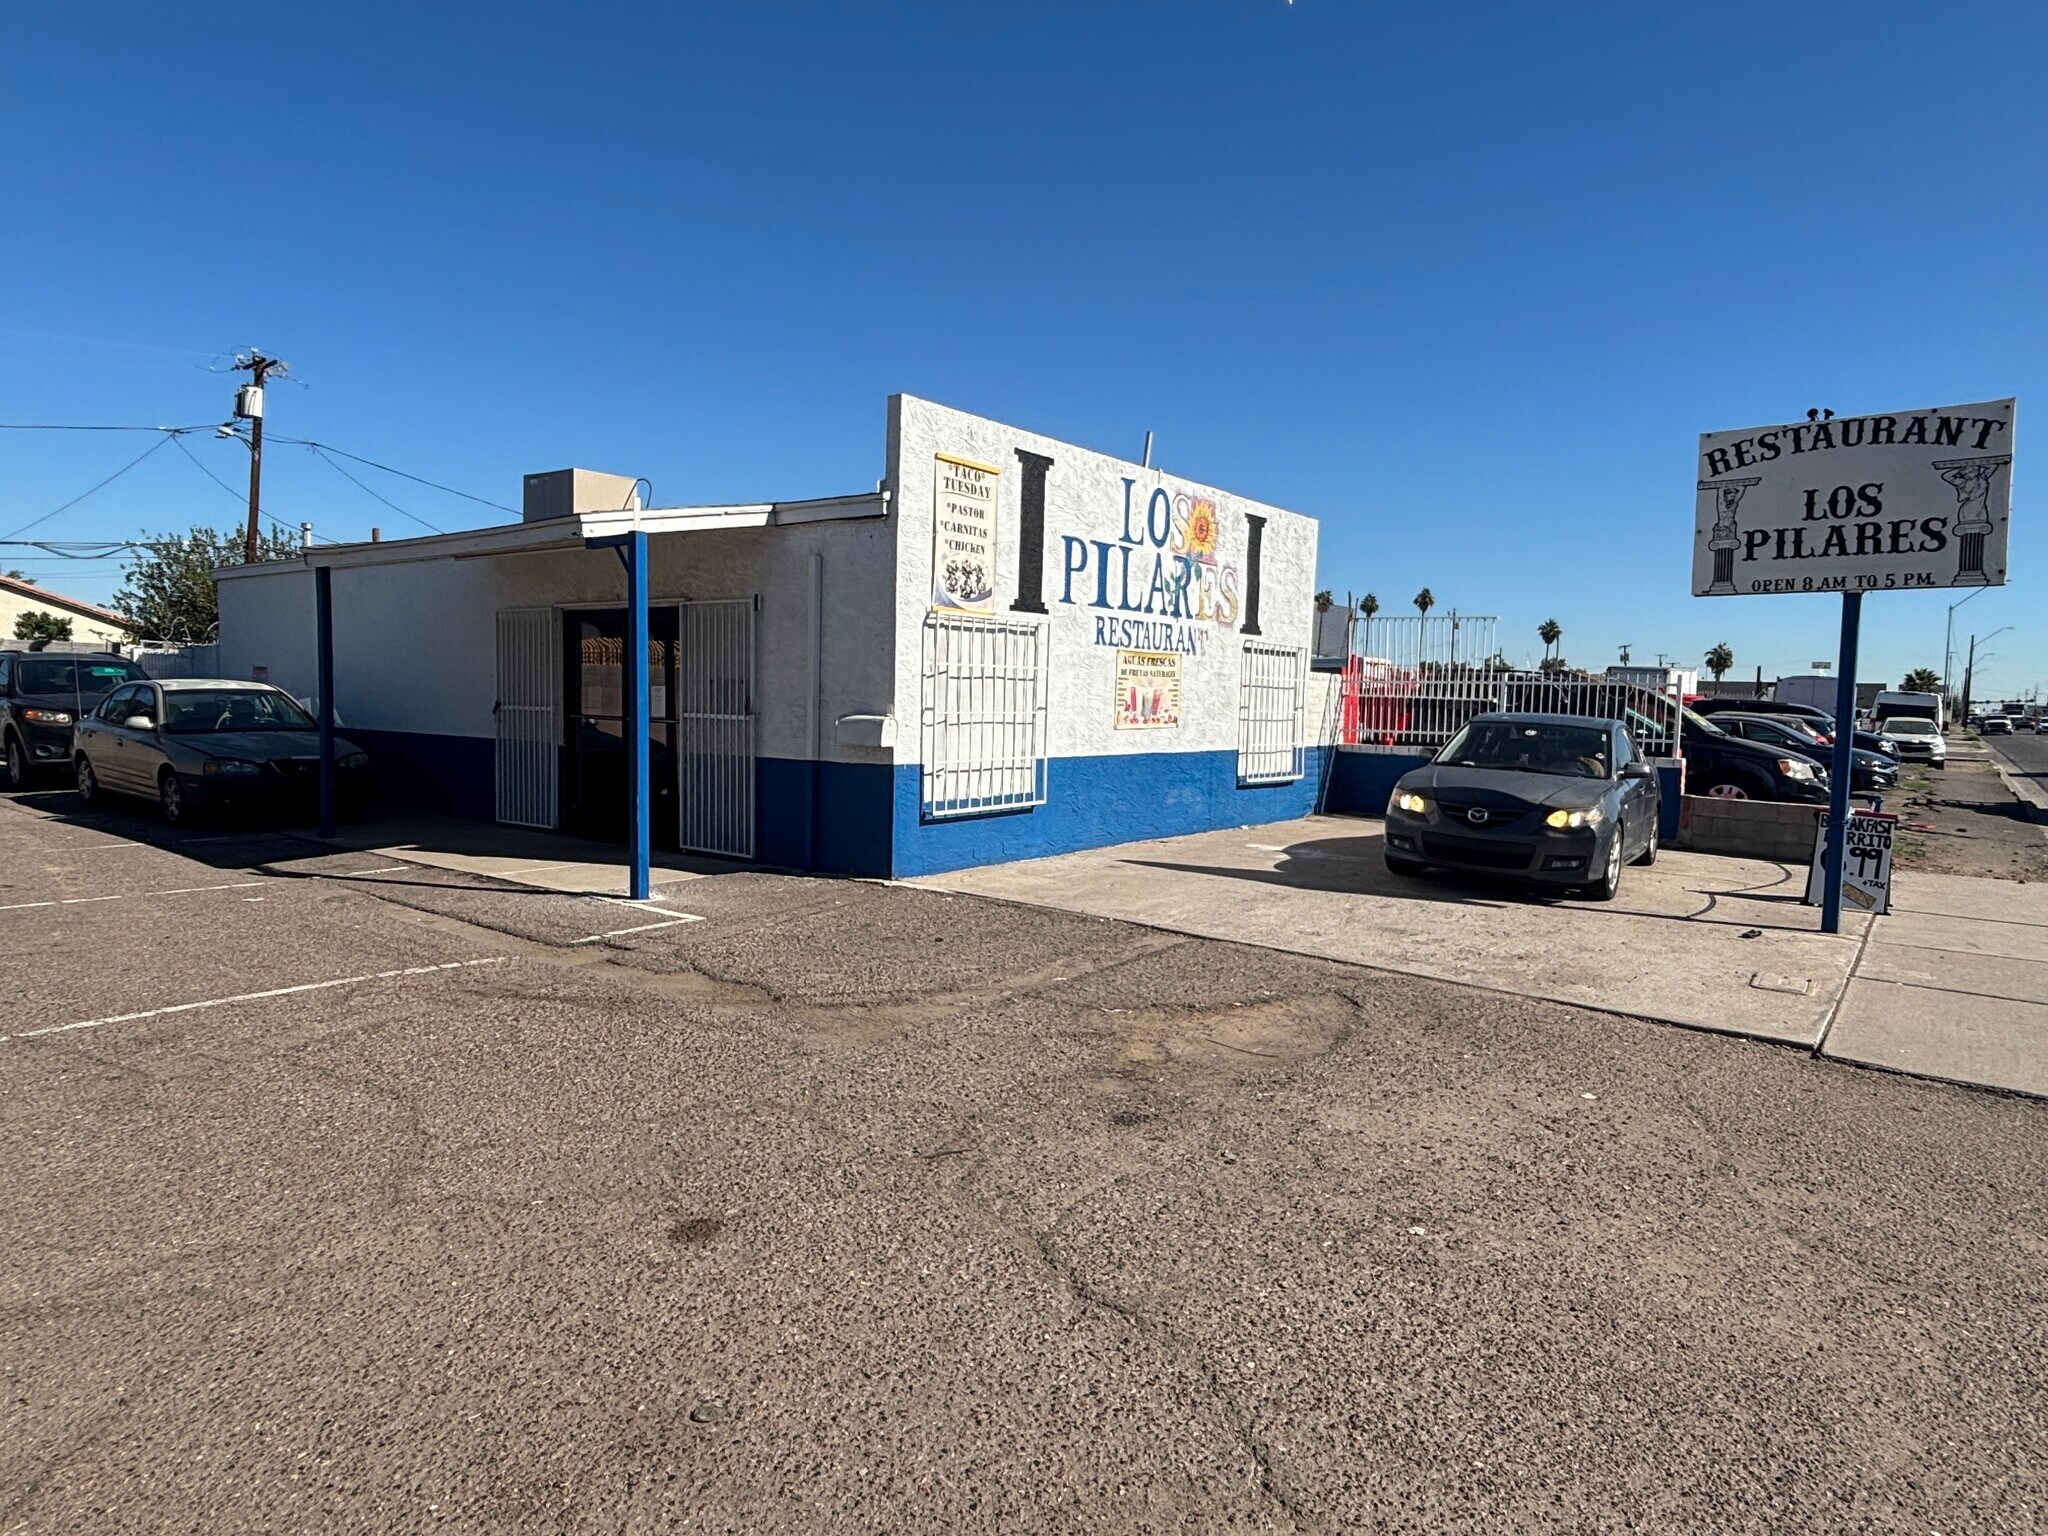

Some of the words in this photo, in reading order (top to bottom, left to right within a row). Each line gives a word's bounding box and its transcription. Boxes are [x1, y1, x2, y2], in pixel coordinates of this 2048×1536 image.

[1703, 416, 2007, 478] RESTAURANT
[943, 477, 991, 499] TUESDAY
[1802, 483, 1884, 521] LOS
[1119, 477, 1192, 555] LOS
[1742, 517, 1948, 562] PILARES
[1058, 535, 1238, 625] PILARES
[1752, 578, 1795, 592] OPEN
[1802, 576, 1814, 591] 8
[1817, 576, 1847, 590] AM
[1855, 574, 1878, 588] TO
[1885, 573, 1896, 588] 5
[1094, 615, 1209, 656] RESTAURANT
[1820, 814, 1894, 834] BAKFAST
[1824, 830, 1892, 850] RRITO
